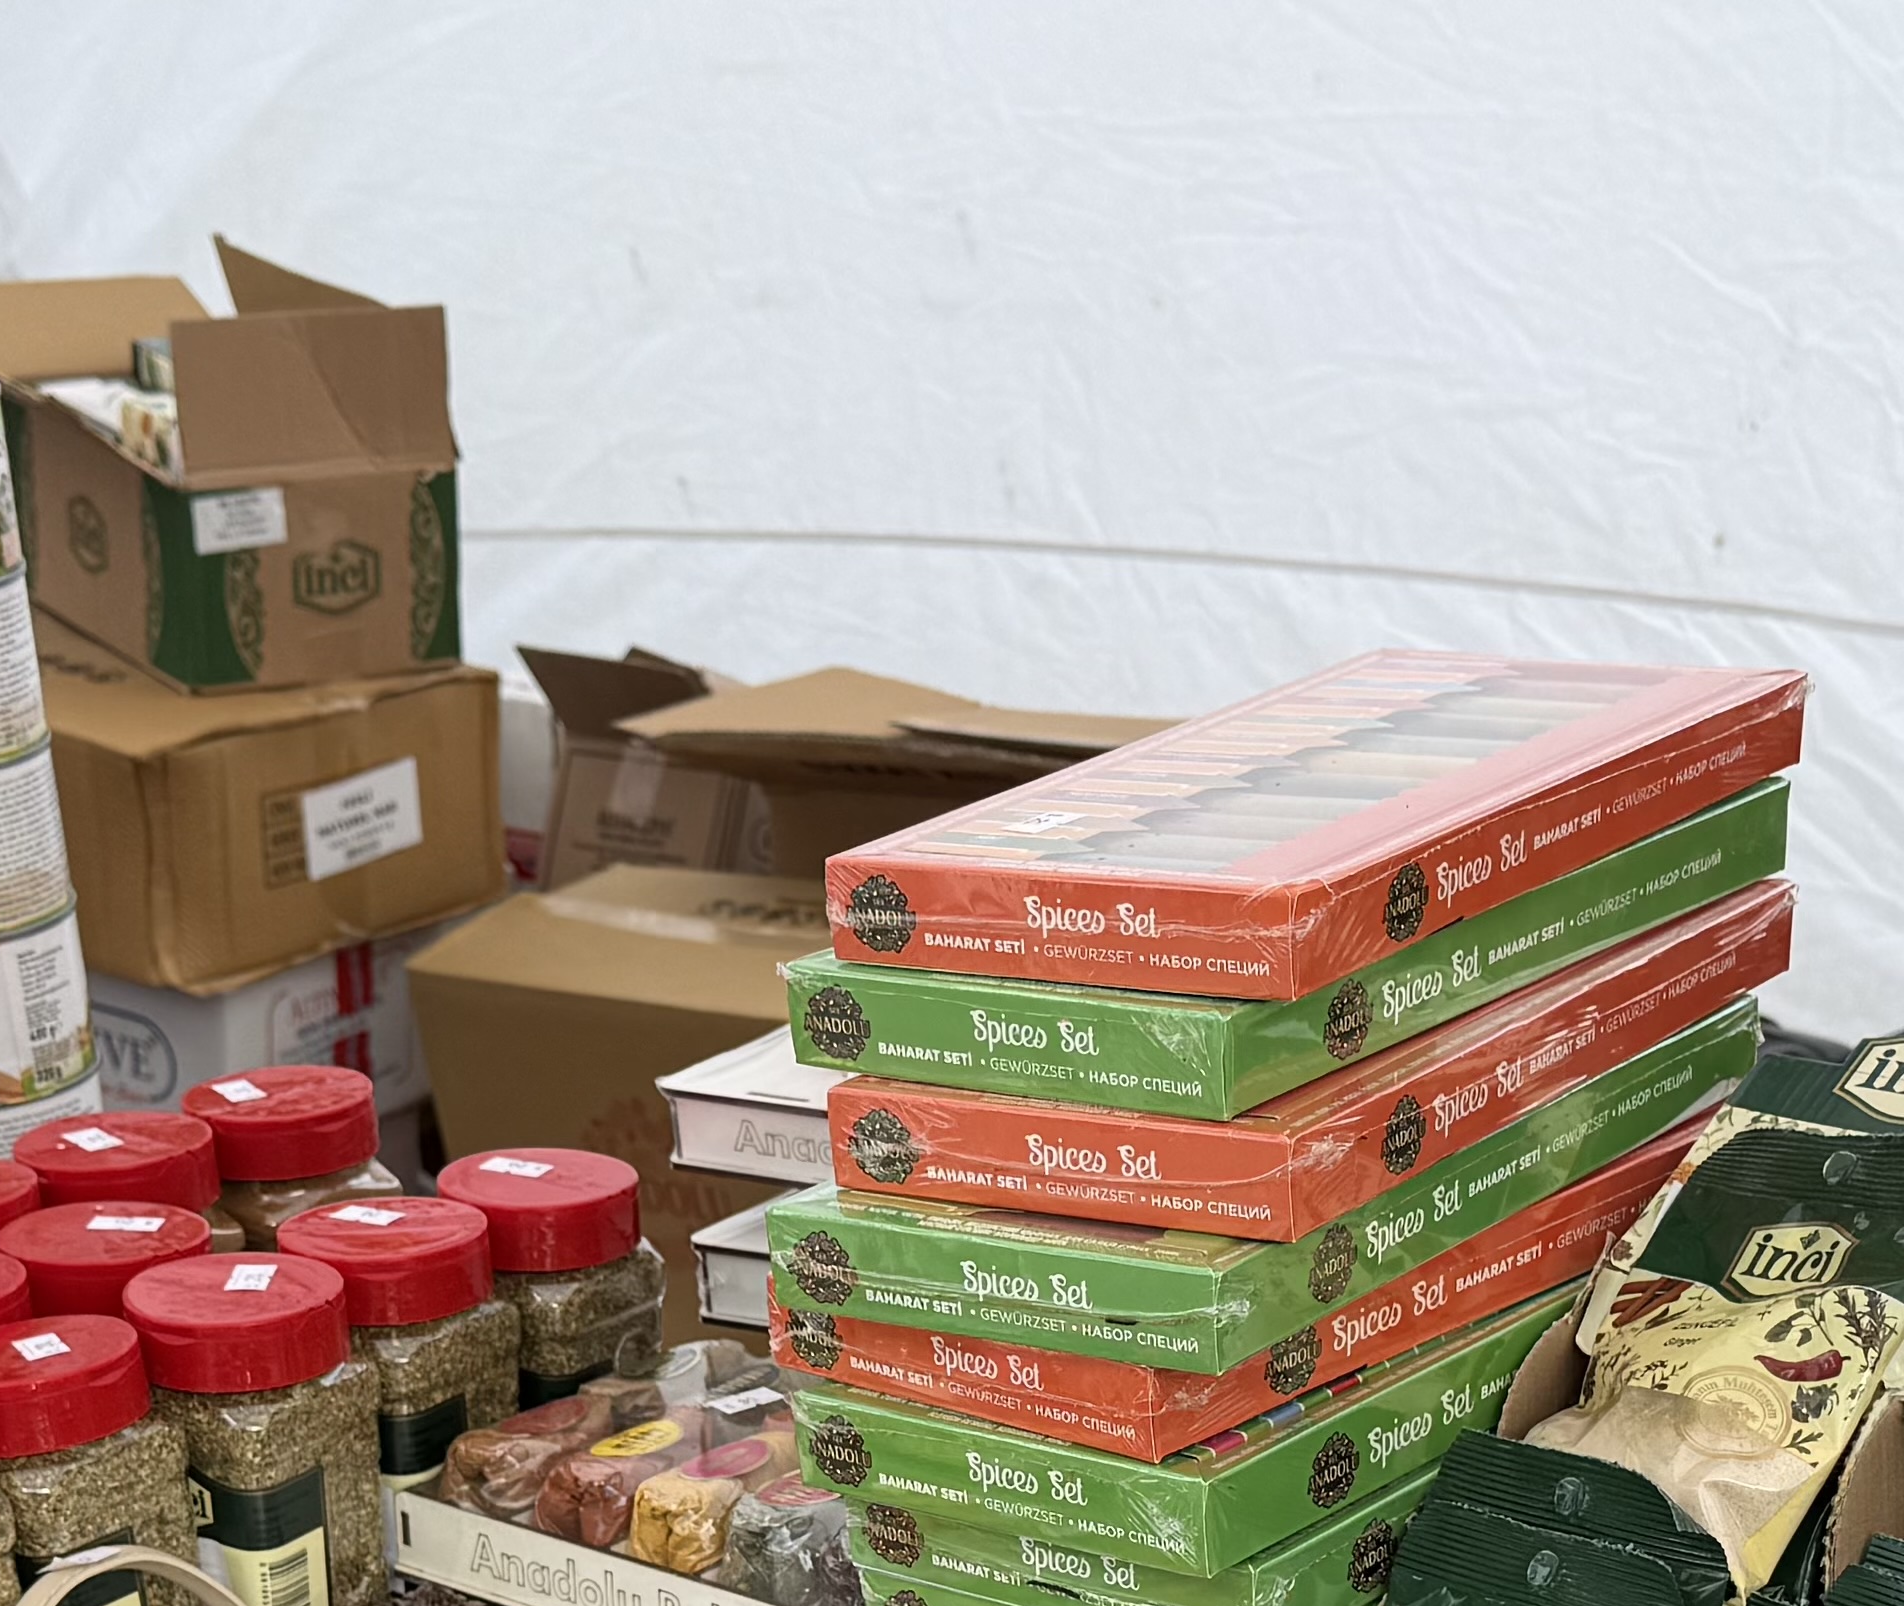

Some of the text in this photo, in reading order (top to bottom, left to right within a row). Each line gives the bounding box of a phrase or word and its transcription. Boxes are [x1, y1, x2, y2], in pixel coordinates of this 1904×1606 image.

[305, 557, 369, 596] inci
[1024, 896, 1162, 939] Spices Set
[924, 931, 990, 952] BAHARAT
[1044, 944, 1134, 966] GEWÜRZSET
[1149, 954, 1270, 977] НАБОР СПЕЦИЙ
[803, 1014, 871, 1039] ANADOLU
[969, 1009, 1100, 1056] Spices Set
[878, 1042, 941, 1063] BAHARAT
[990, 1055, 1076, 1080] GEWÜRZSET
[1089, 1070, 1203, 1097] НАБОР СПЕЦИЙ
[1737, 1234, 1842, 1284] inci
[959, 1259, 1093, 1310] Spices Set
[865, 1289, 930, 1311] BAHARAT
[980, 1307, 1067, 1332] GEWÜRZSET
[1330, 1301, 1402, 1355] Spices
[1412, 1276, 1449, 1317] Set
[1456, 1256, 1515, 1293] BAHARAT
[1081, 1323, 1199, 1353] НАБОР СПЕЦИЙ
